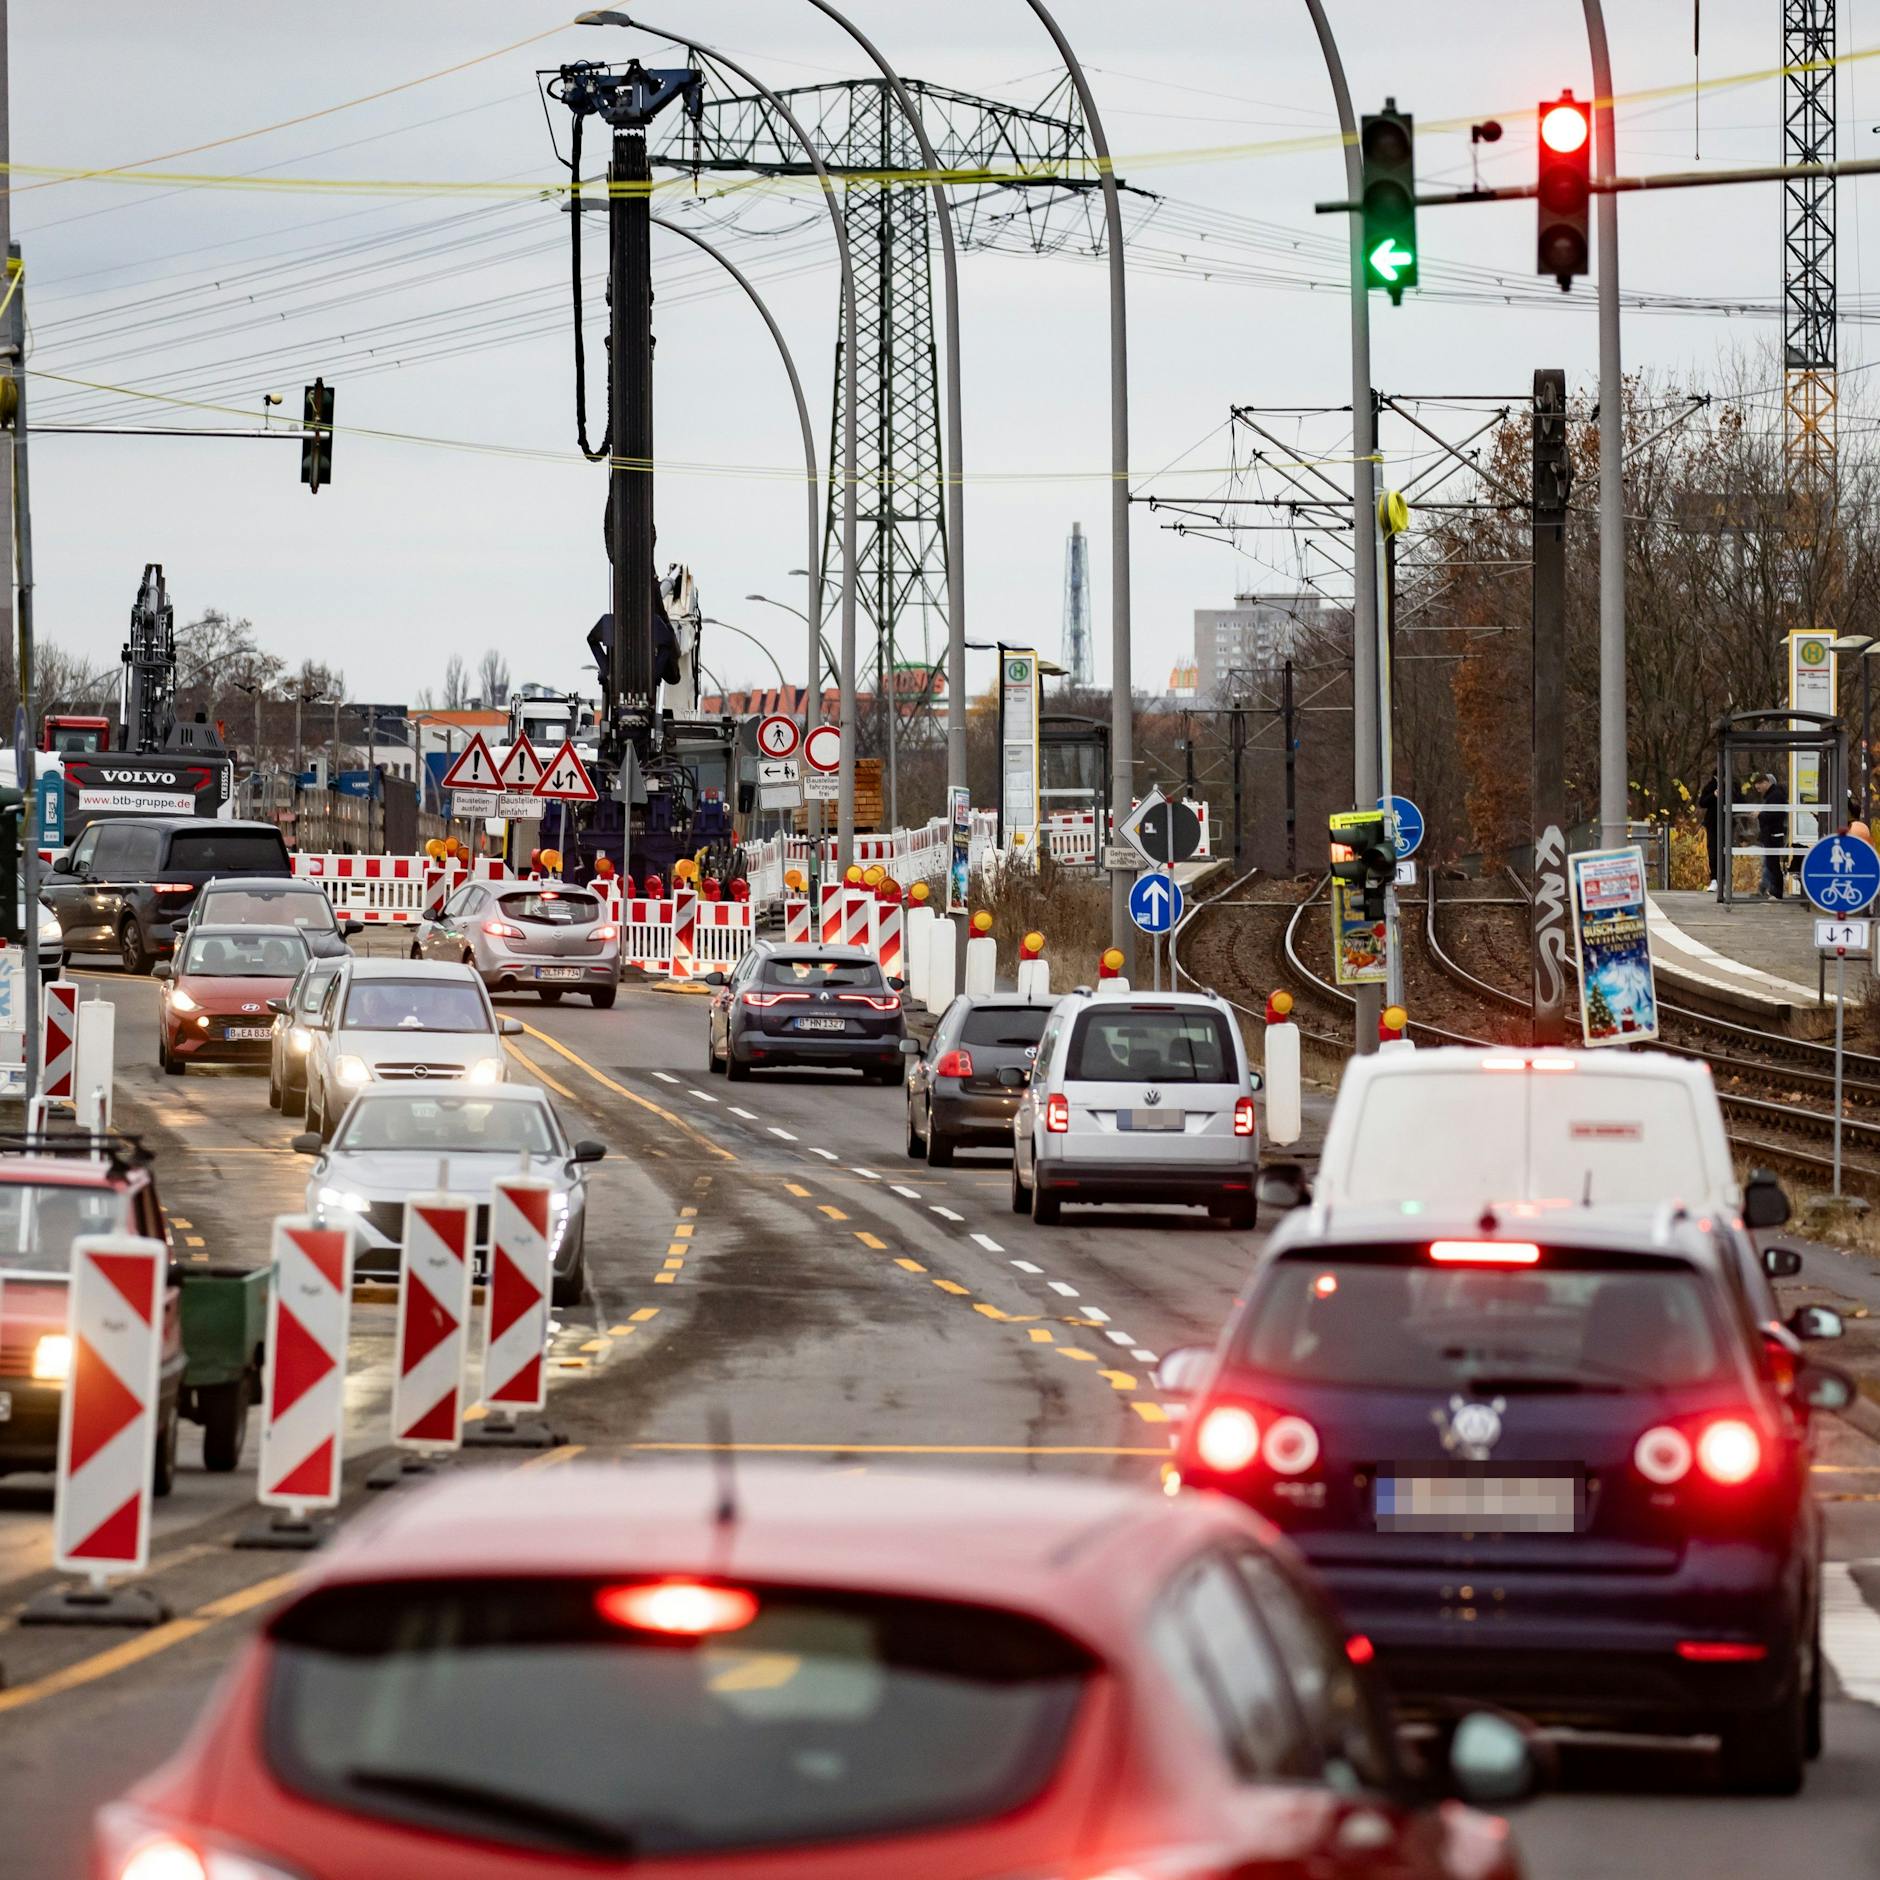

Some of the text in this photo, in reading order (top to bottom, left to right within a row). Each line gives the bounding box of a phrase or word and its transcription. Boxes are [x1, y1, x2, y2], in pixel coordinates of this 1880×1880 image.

[101, 770, 176, 785] VOLVO
[83, 795, 191, 809] www.btb-gruppe.de
[456, 796, 492, 804] Baustellen-
[500, 795, 541, 804] Baustellen-
[500, 807, 528, 815] einfahrt
